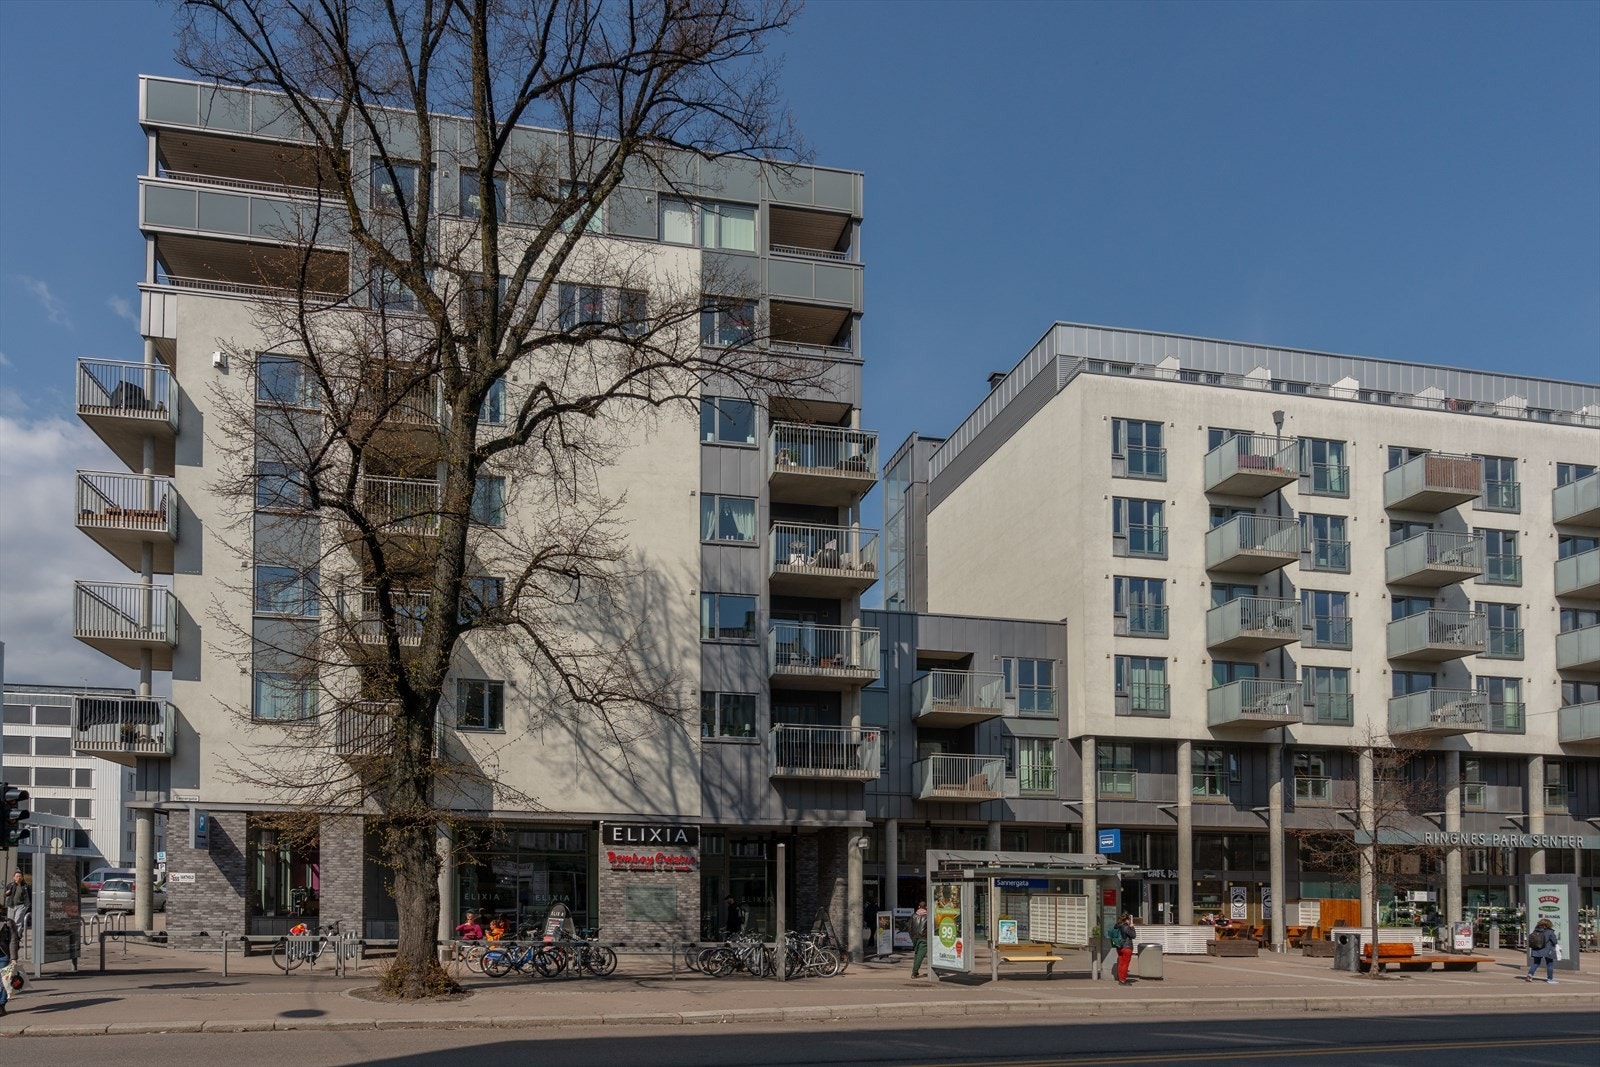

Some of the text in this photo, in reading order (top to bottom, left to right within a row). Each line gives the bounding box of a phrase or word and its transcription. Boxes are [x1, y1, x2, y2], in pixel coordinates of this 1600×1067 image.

[613, 827, 688, 842] ELIXIA
[1424, 832, 1584, 848] RINGNES PARK SENTER
[607, 851, 654, 865] Bombay
[996, 879, 1029, 888] Sannergata
[50, 890, 68, 898] Brands
